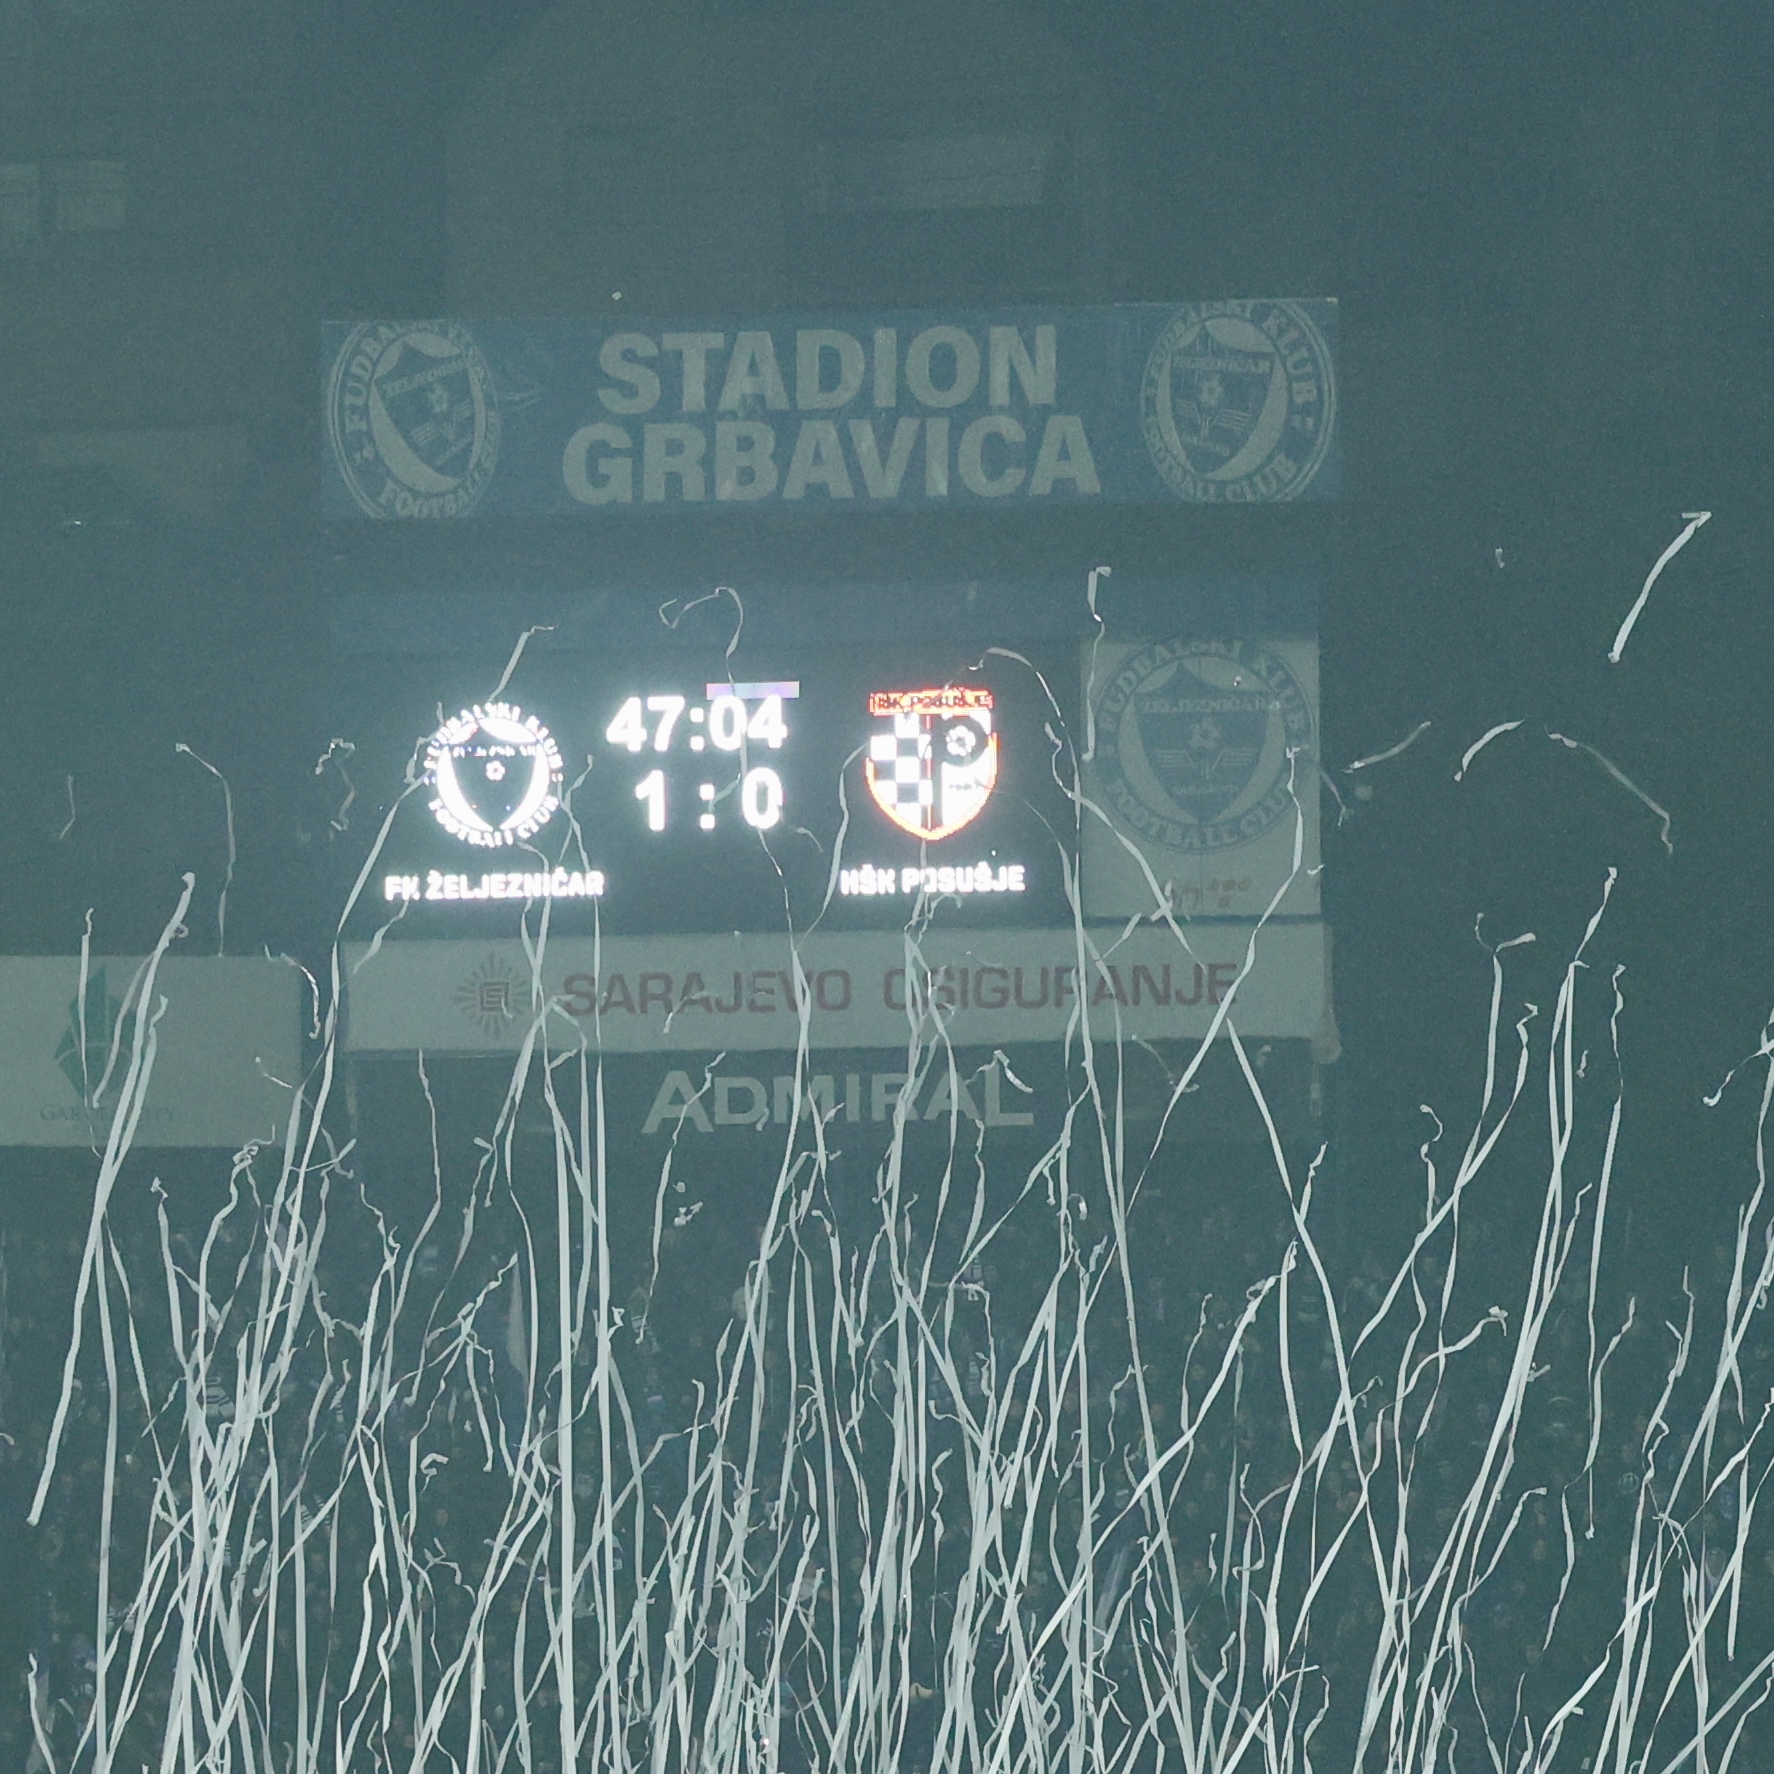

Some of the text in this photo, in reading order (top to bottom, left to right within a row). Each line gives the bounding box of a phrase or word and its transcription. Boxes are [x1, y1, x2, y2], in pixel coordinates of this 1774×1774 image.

[597, 325, 1057, 414] STADION
[562, 413, 1101, 505] GRBAVICA
[606, 694, 787, 752] 47:04
[425, 866, 604, 900] ŽELJEZNIČAR
[901, 861, 1026, 893] POSUŠJE
[562, 968, 852, 1016] SARAJEVO
[641, 1061, 1035, 1134] ADMIRAL
